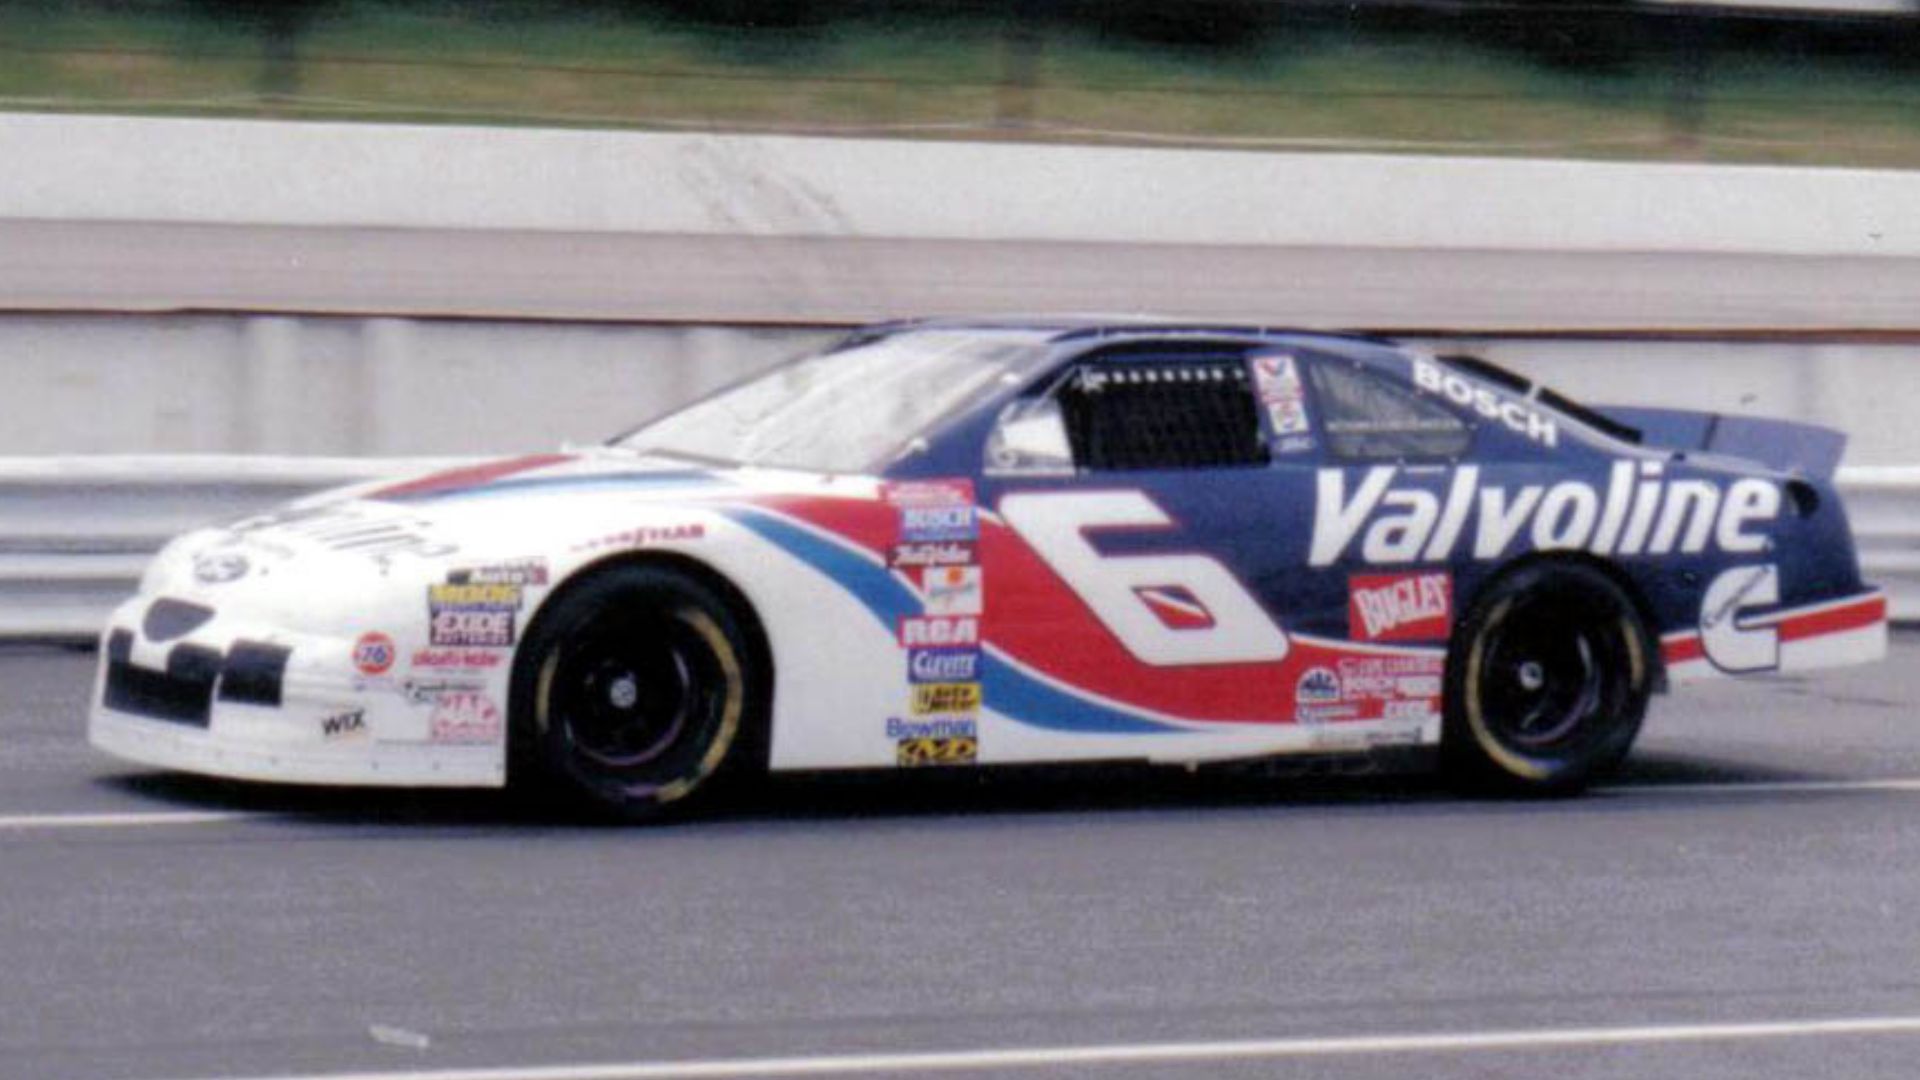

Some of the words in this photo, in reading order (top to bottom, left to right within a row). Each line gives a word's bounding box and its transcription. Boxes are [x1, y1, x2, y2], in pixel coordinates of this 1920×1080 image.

[1413, 358, 1558, 447] BOSCH
[1308, 461, 1780, 566] Valvoline
[999, 489, 1289, 666] 6
[433, 612, 511, 632] EXIDE
[903, 618, 976, 644] RCA
[361, 646, 387, 665] 76
[322, 707, 367, 736] WIX
[886, 717, 976, 738] Bowman
